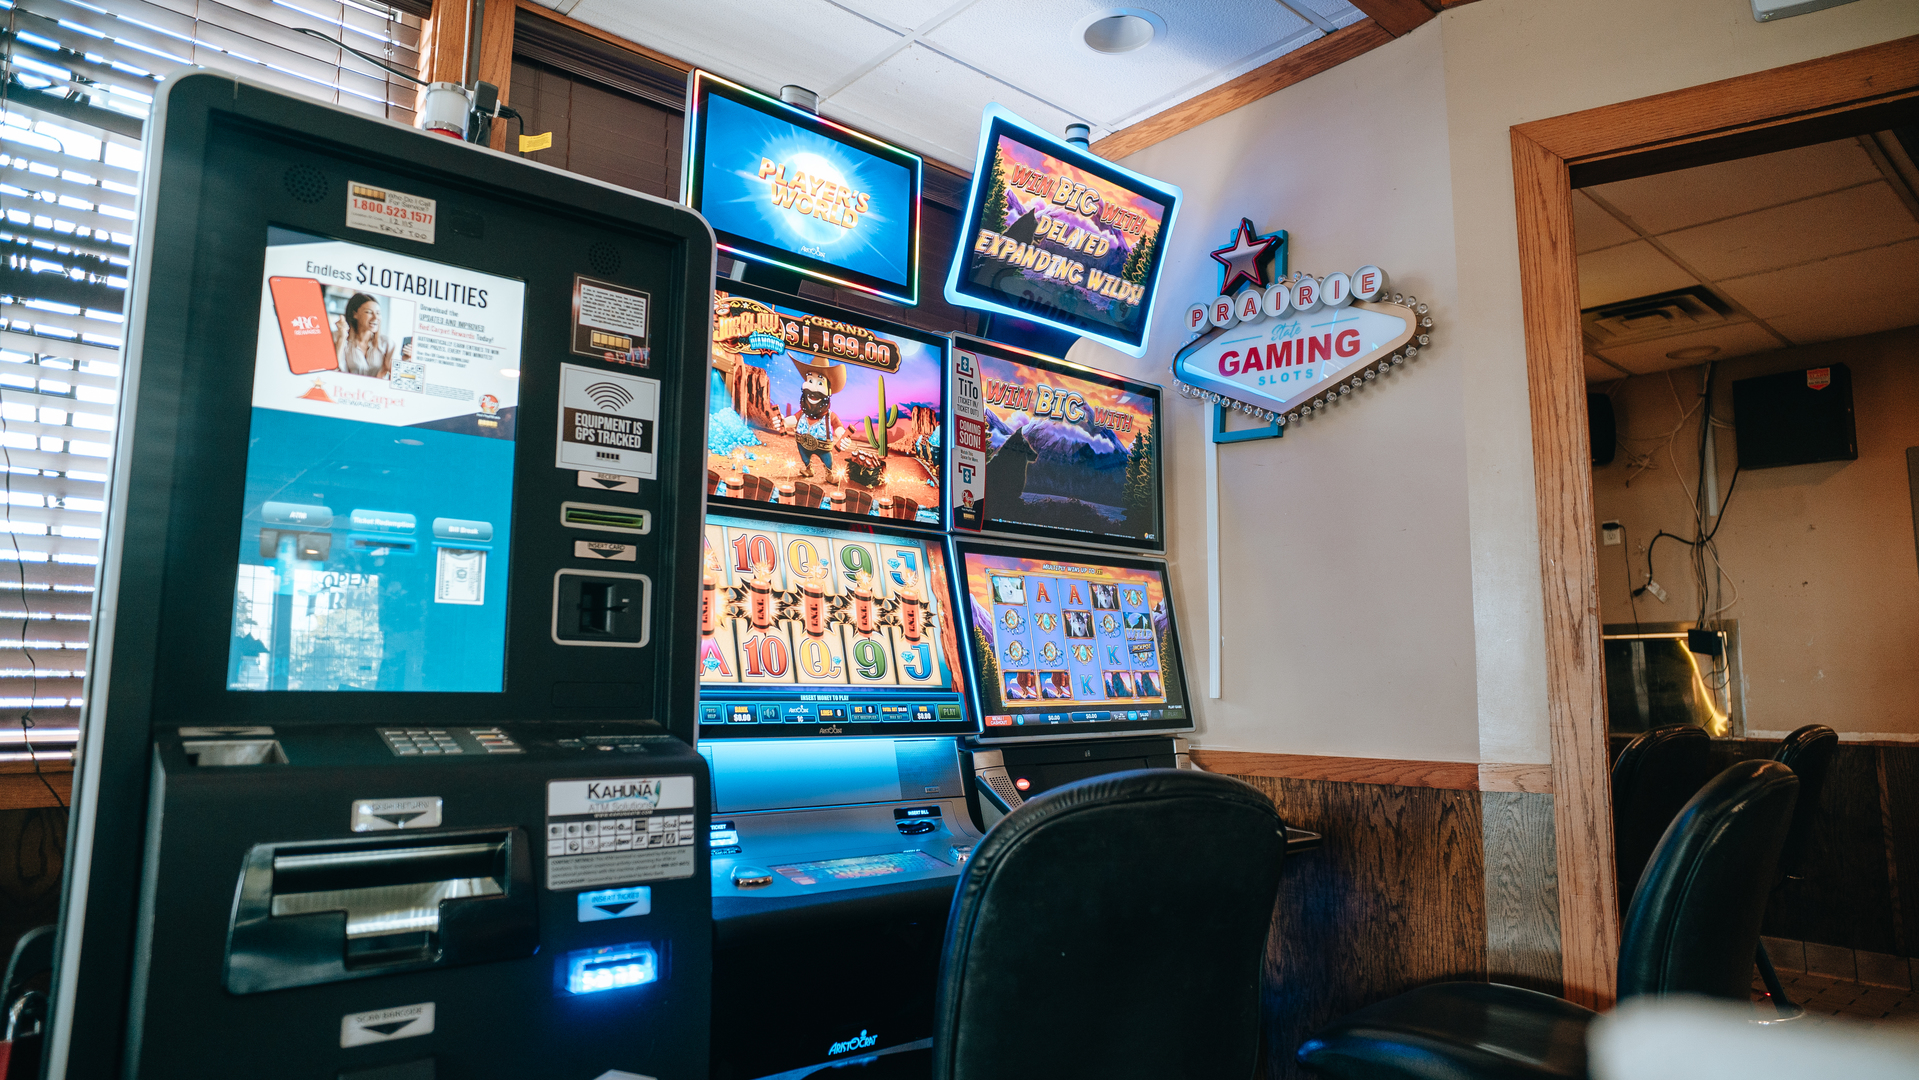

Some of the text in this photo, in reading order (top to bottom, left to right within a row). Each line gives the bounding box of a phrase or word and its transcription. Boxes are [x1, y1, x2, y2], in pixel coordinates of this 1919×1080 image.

[758, 157, 871, 214] PLAYER'S
[771, 183, 859, 230] WORLD
[1011, 163, 1147, 235] WIN BIG WITH
[353, 198, 433, 225] 1.800.523.1577
[1034, 215, 1111, 258] DELAYED
[974, 228, 1145, 307] EXPANDING WILDS!
[306, 260, 489, 309] Endless $LOTABILITIES
[1191, 272, 1376, 328] PRAIRIE
[811, 316, 869, 338] GRAND
[1271, 321, 1302, 342] State
[785, 321, 891, 366] $1,199.00
[1218, 328, 1361, 377] GAMING
[958, 377, 978, 400] TiTo
[1258, 368, 1313, 386] SLOTS
[986, 378, 1134, 432] WIN BIG WITH
[575, 412, 643, 436] EQUIPMENT IS
[959, 419, 982, 436] COMING
[575, 426, 642, 449] GPS TRACKED
[959, 431, 981, 449] SOON!
[732, 534, 777, 574] 10
[787, 538, 828, 579] Q
[840, 543, 873, 583] 9
[890, 550, 918, 587] J
[1042, 563, 1066, 572] MULTIPLY
[1036, 581, 1084, 605] A A
[1126, 628, 1154, 641] WILD
[742, 634, 790, 678] 10
[799, 637, 841, 679] Q
[852, 639, 888, 680] 9
[904, 642, 933, 681] J
[1107, 645, 1122, 666] K
[1132, 643, 1152, 652] JACKPOT
[1080, 674, 1096, 696] K
[733, 714, 752, 722] $0.00
[588, 782, 653, 800] KAHUNA
[588, 800, 654, 813] ATM Solutions
[591, 892, 640, 903] INSERT TICKET
[828, 1029, 878, 1056] ARISTOCRAT
